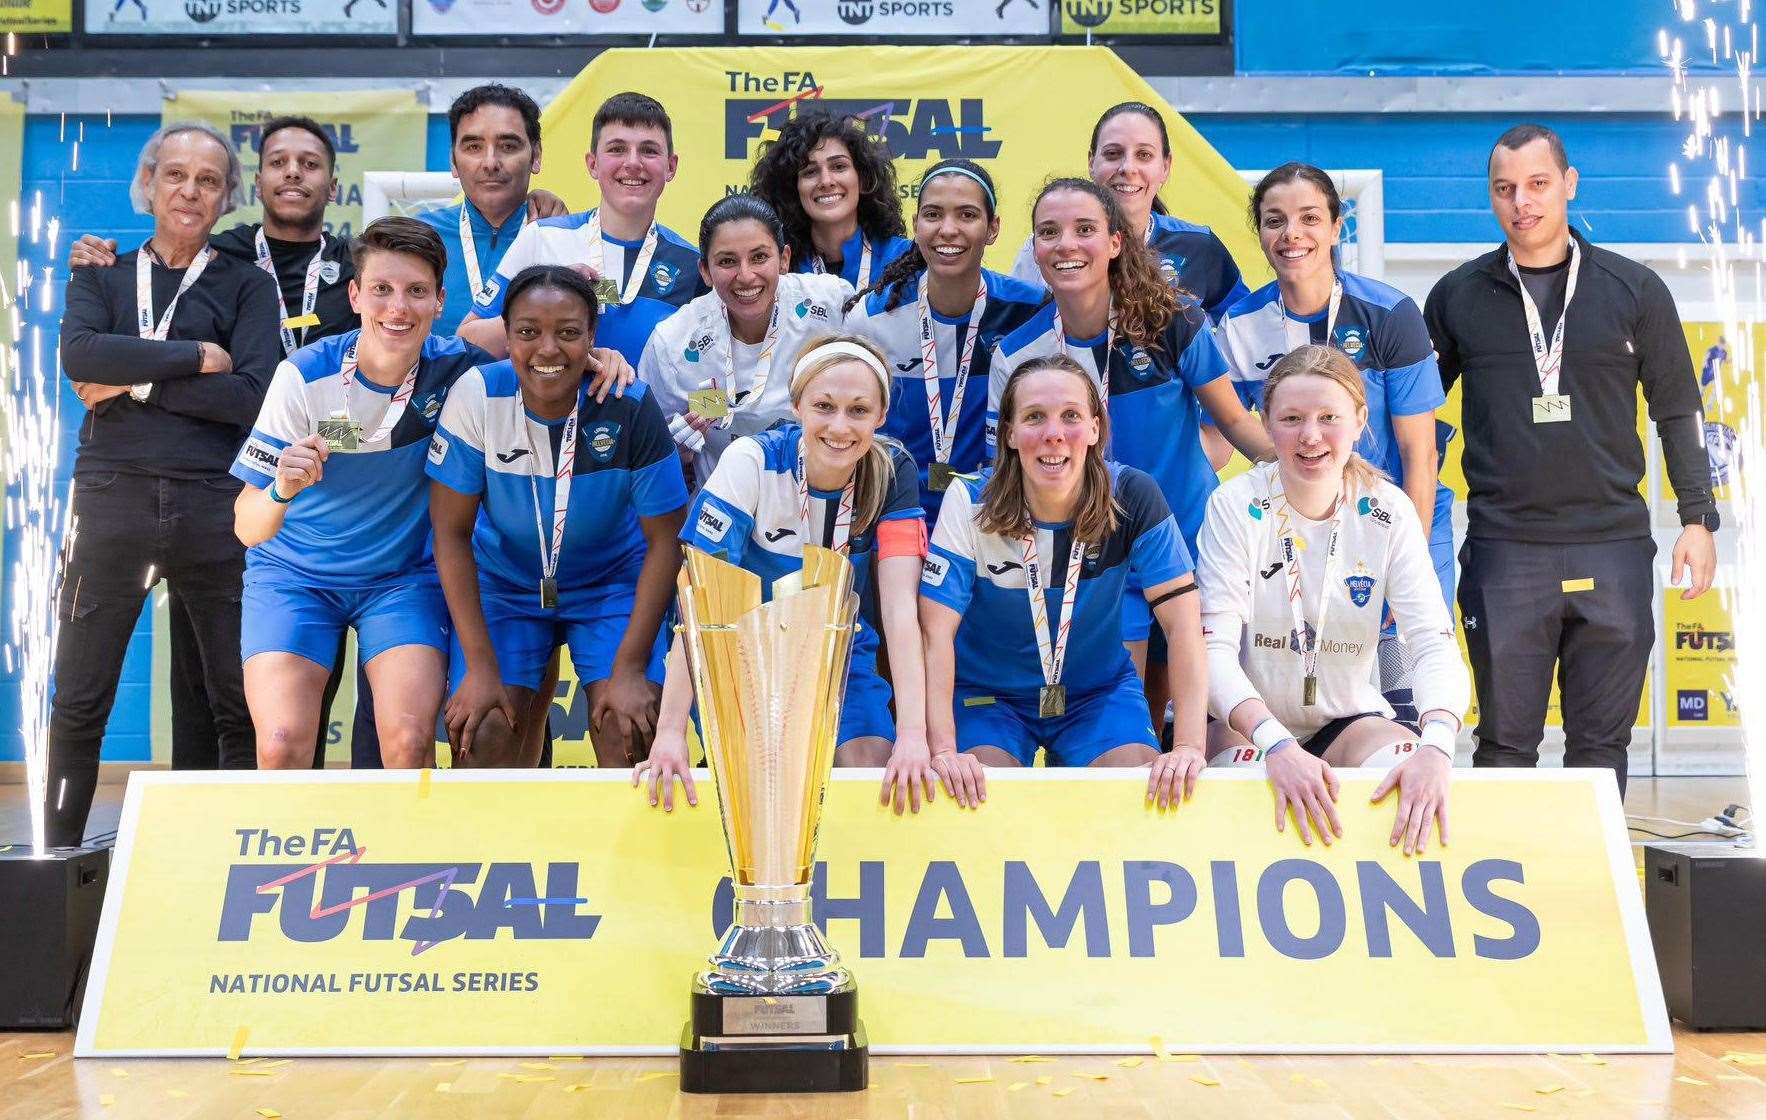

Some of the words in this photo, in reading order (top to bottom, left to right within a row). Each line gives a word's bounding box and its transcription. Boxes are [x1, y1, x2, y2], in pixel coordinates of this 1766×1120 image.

[227, 0, 302, 13] SPORTS
[880, 2, 954, 16] SPORTS
[1120, 0, 1215, 14] SPORTS
[726, 71, 779, 93] The
[783, 71, 818, 93] FA
[810, 305, 828, 319] SBL
[921, 316, 930, 340] FUTSAL
[565, 416, 575, 443] FUTSAL
[933, 427, 942, 451] FUTSAL
[1371, 507, 1392, 525] SBL
[1284, 537, 1294, 563] FUTSAL
[1028, 563, 1039, 590] FUTSAL
[1254, 633, 1287, 650] Real
[1320, 639, 1364, 657] Money
[1051, 657, 1061, 684] FUTSAL
[1680, 697, 1705, 710] MD
[235, 828, 306, 857] The
[310, 828, 359, 857] FA
[217, 861, 603, 944] FUTSAL
[713, 857, 1542, 960] HAMPIONS
[209, 974, 342, 994] NATIONAL
[348, 973, 445, 992] FUTSAL
[452, 971, 539, 991] SERIES
[750, 1021, 801, 1031] WINNERS
